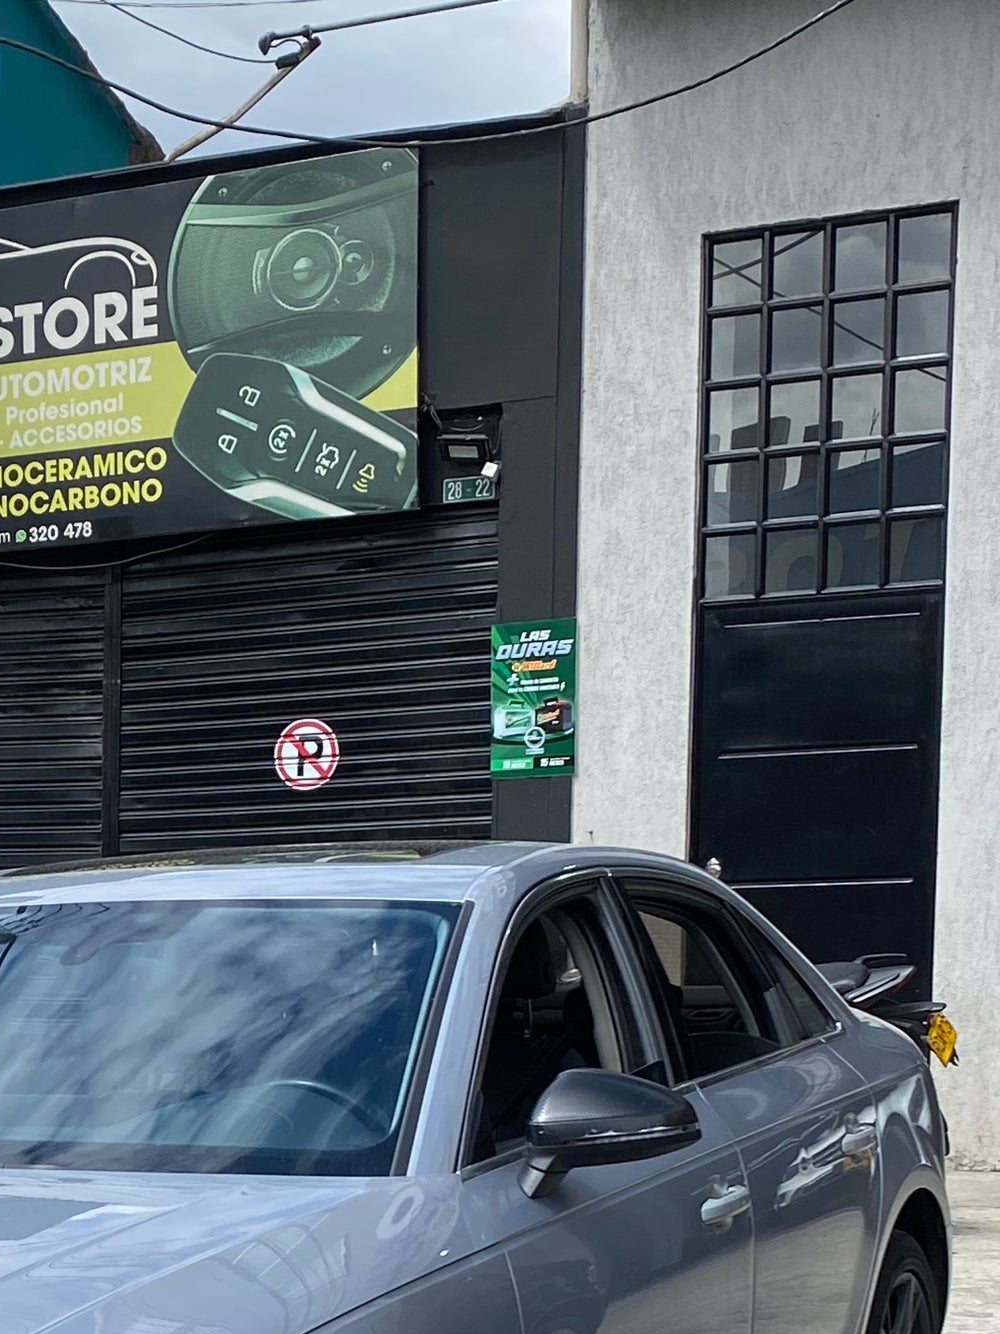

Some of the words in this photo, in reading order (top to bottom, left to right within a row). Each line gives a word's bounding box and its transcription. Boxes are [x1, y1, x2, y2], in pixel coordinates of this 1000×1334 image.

[5, 392, 125, 427] Profesional
[9, 415, 143, 449] ACCESORIOS
[28, 524, 59, 543] 320
[63, 521, 93, 541] 478
[519, 629, 551, 643] LAS
[495, 638, 574, 661] DURAS
